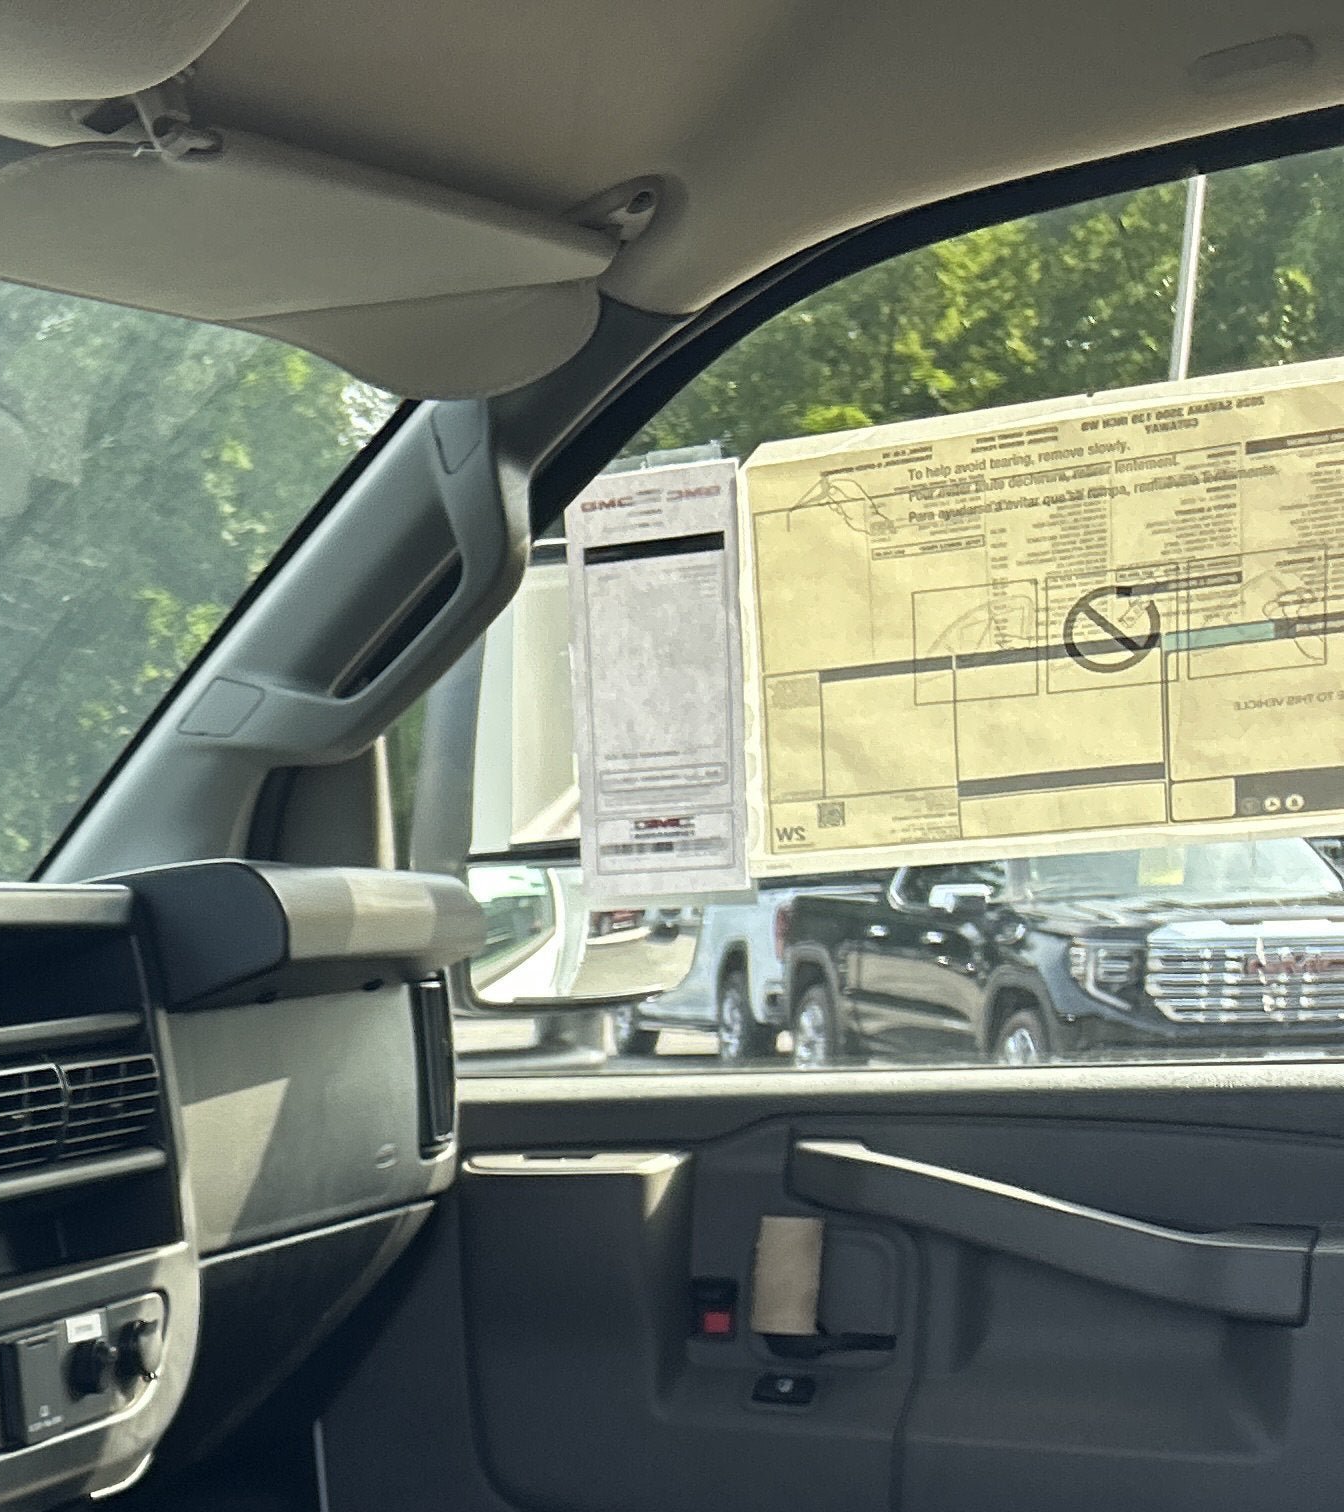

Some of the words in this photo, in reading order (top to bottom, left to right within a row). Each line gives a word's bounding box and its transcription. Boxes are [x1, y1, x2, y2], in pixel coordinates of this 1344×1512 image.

[908, 468, 923, 481] To
[926, 465, 952, 479] help
[954, 459, 986, 475] avoid
[990, 454, 1034, 469] tearing,
[1038, 447, 1084, 462] remove
[1088, 440, 1131, 456] slowly.
